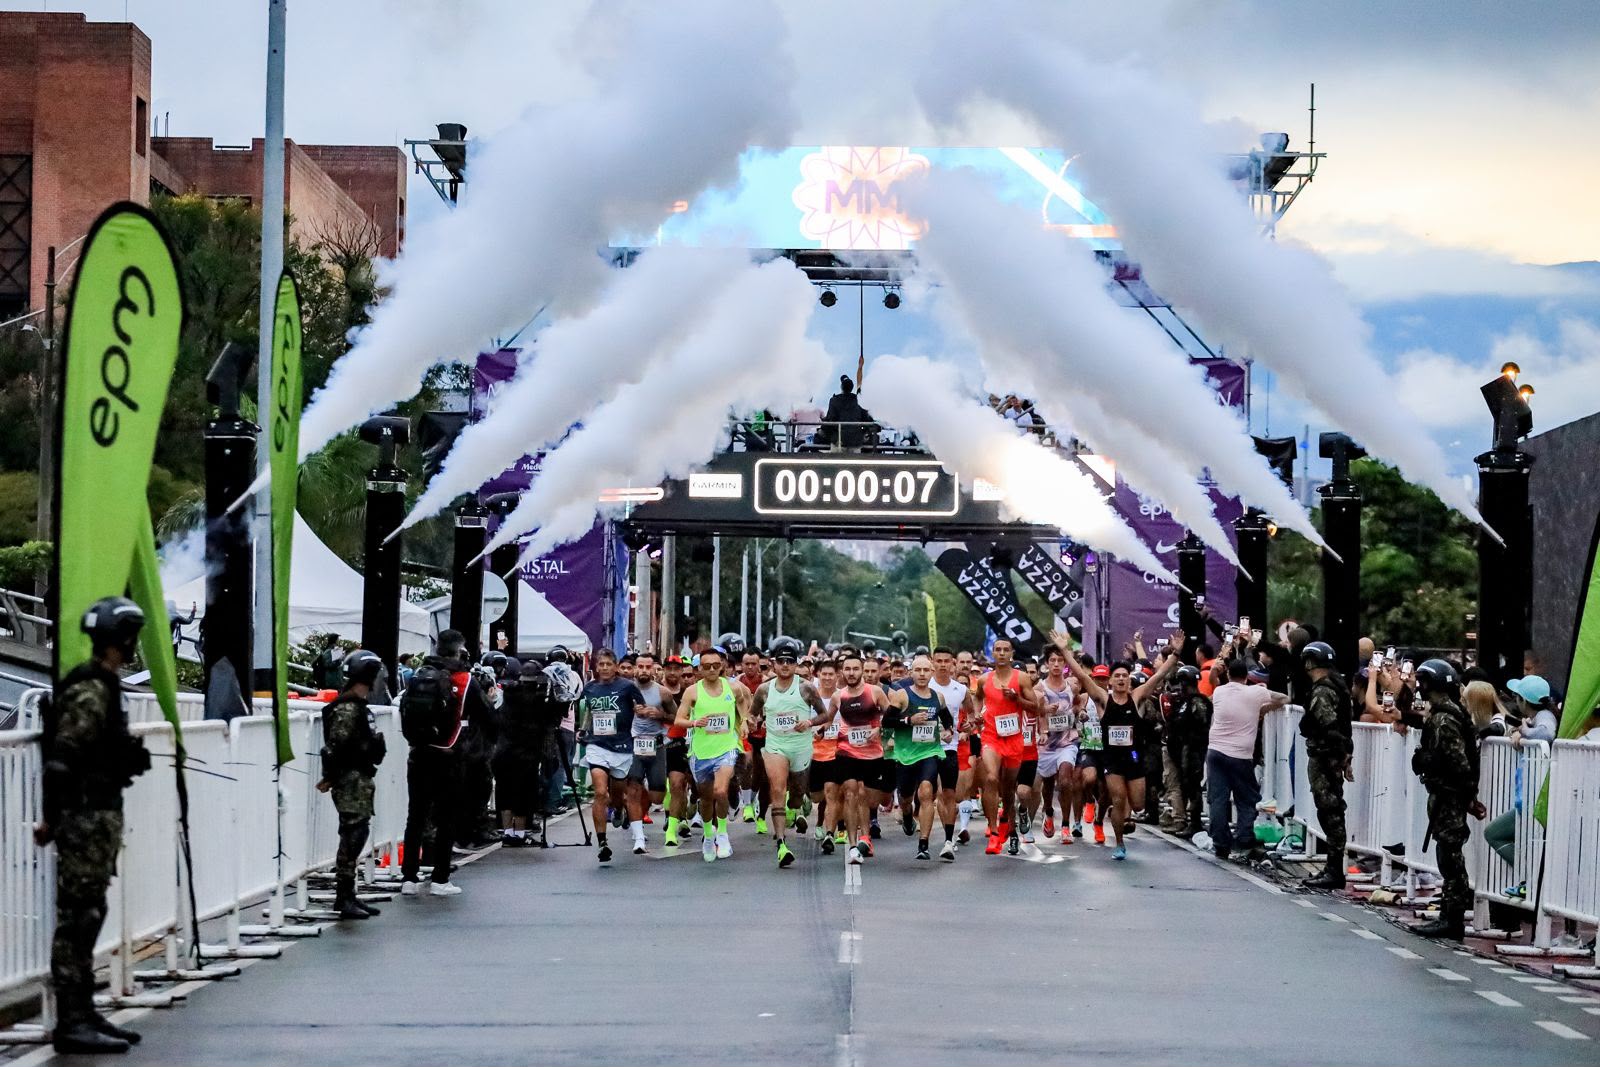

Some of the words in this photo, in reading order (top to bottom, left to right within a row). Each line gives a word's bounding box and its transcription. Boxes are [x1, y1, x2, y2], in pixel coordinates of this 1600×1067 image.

[825, 179, 904, 214] MM
[90, 266, 155, 447] epm
[775, 469, 939, 504] 00:00:07
[967, 562, 1015, 614] GLOBAL
[1027, 545, 1079, 600] GLOBAL
[709, 717, 725, 726] 7276
[851, 731, 867, 740] 9112
[1000, 719, 1015, 728] 7911
